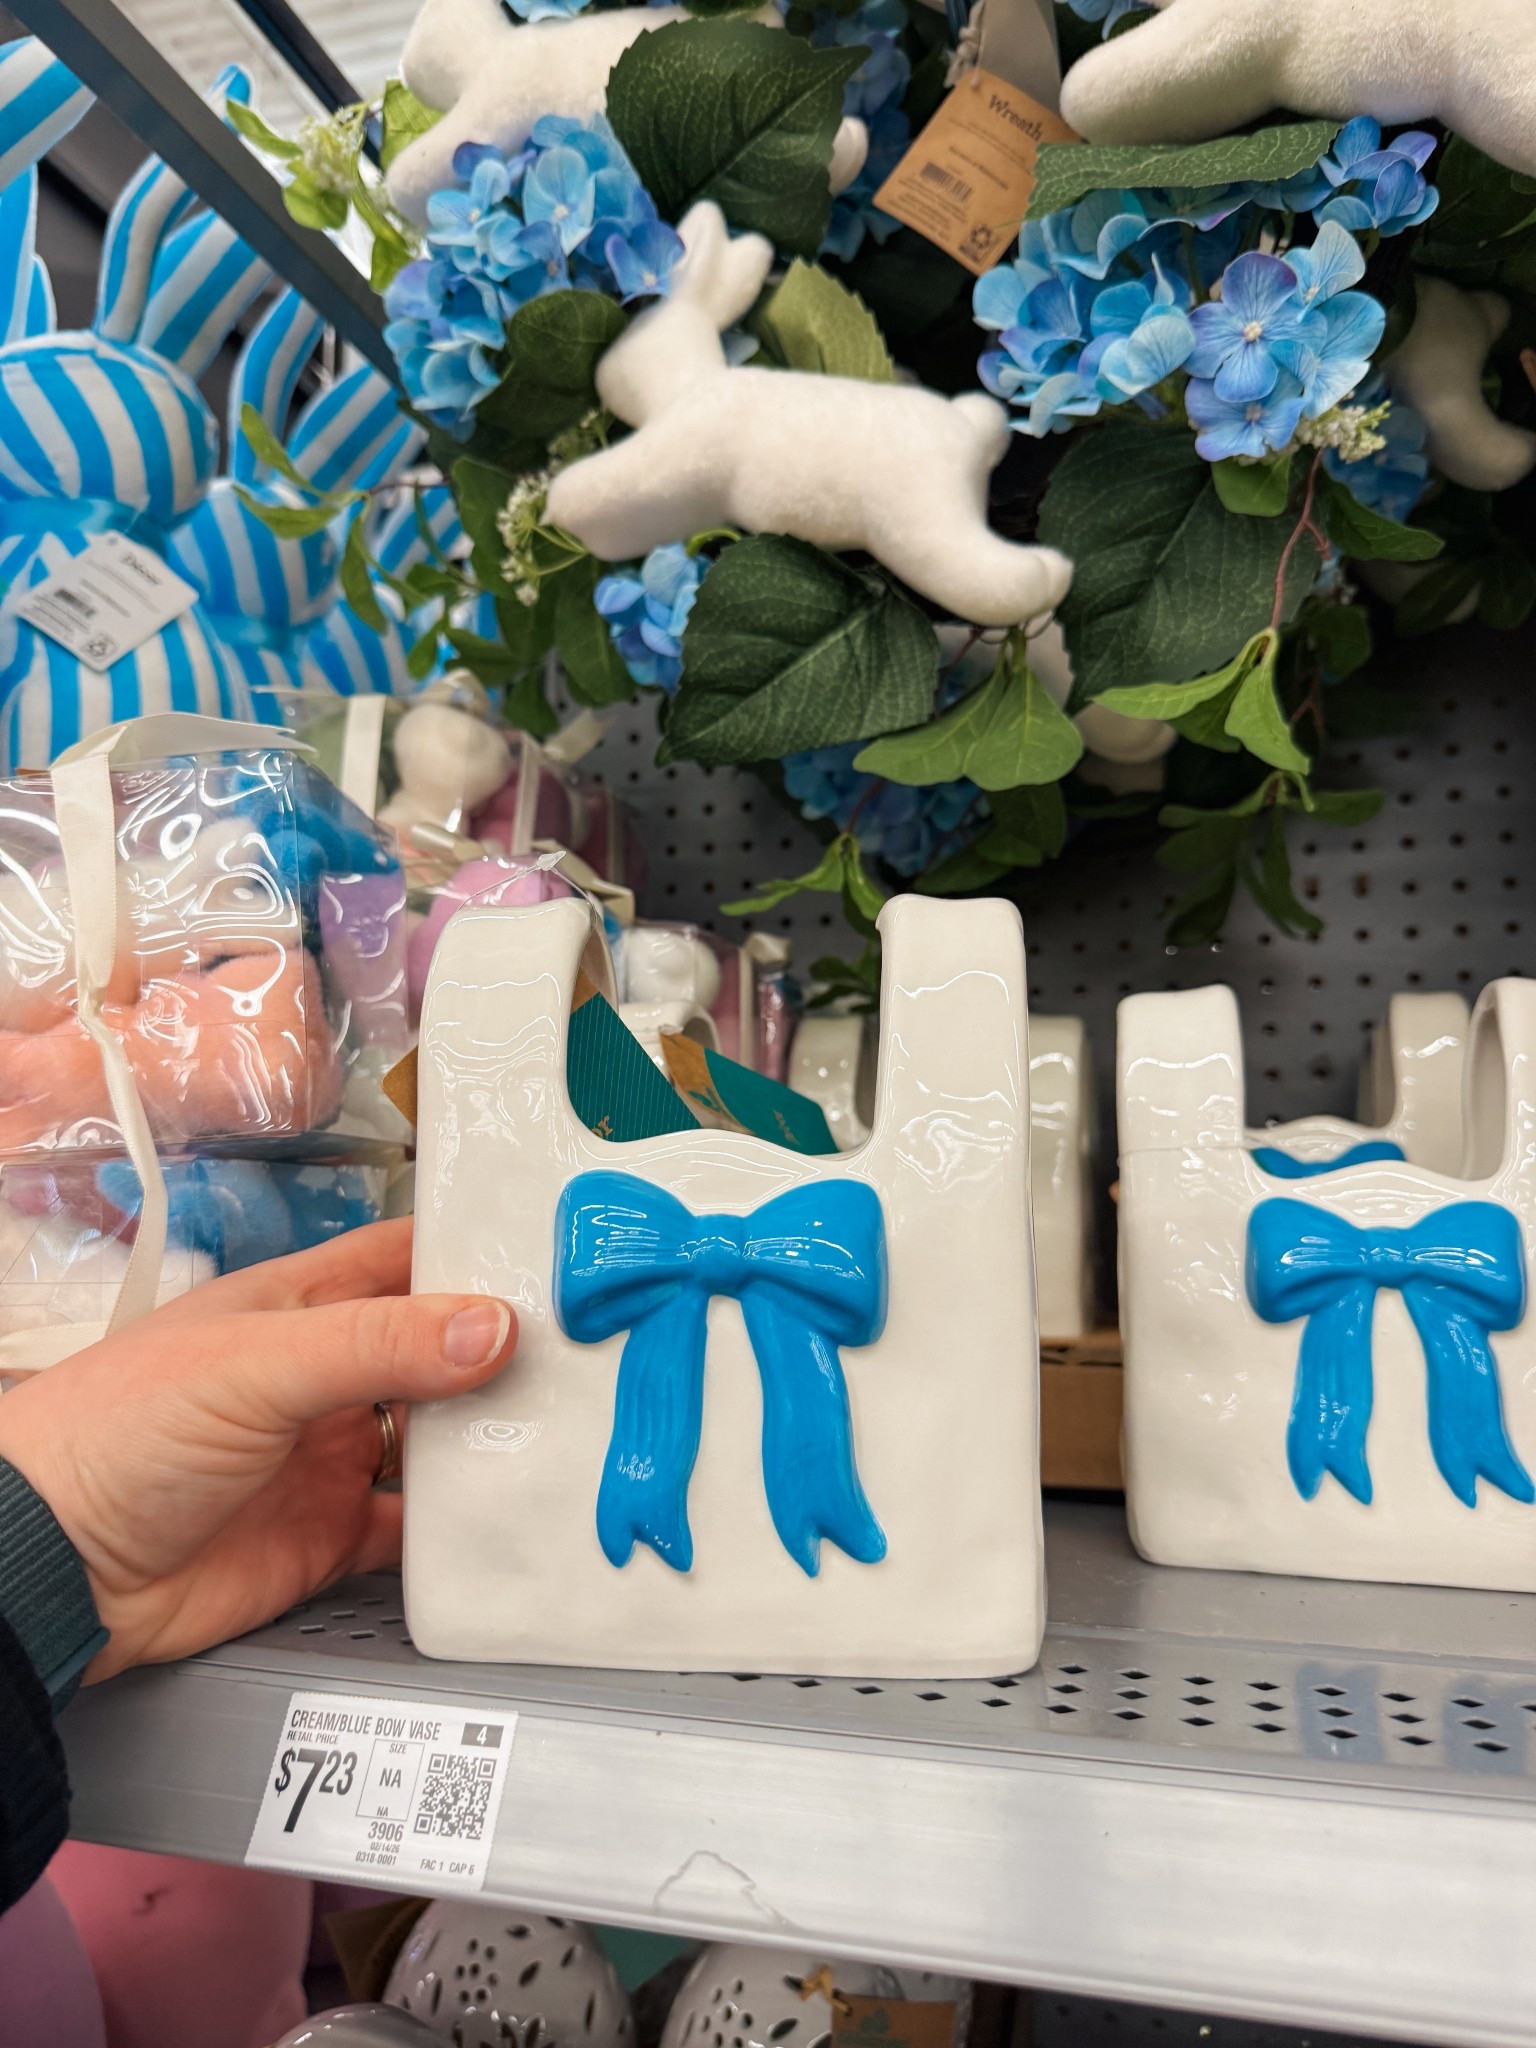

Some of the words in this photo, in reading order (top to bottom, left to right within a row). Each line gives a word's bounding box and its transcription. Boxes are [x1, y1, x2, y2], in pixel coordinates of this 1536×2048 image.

[989, 94, 1043, 142] Wreath
[291, 1709, 373, 1735] CREAM/BLUE
[374, 1717, 406, 1738] BOW
[409, 1720, 442, 1741] VASE
[286, 1730, 314, 1743] RETAIL
[315, 1734, 340, 1745] PRICE
[475, 1726, 488, 1745] 4
[389, 1743, 408, 1755] SIZE
[378, 1768, 402, 1788] NA
[376, 1806, 389, 1817] NA
[368, 1821, 405, 1842] 3906
[370, 1841, 400, 1854] 02/14/26
[377, 1853, 397, 1866] 0001
[420, 1858, 437, 1871] FAC
[439, 1861, 444, 1872] 1
[449, 1862, 468, 1874] CAP
[469, 1864, 475, 1875] 6
